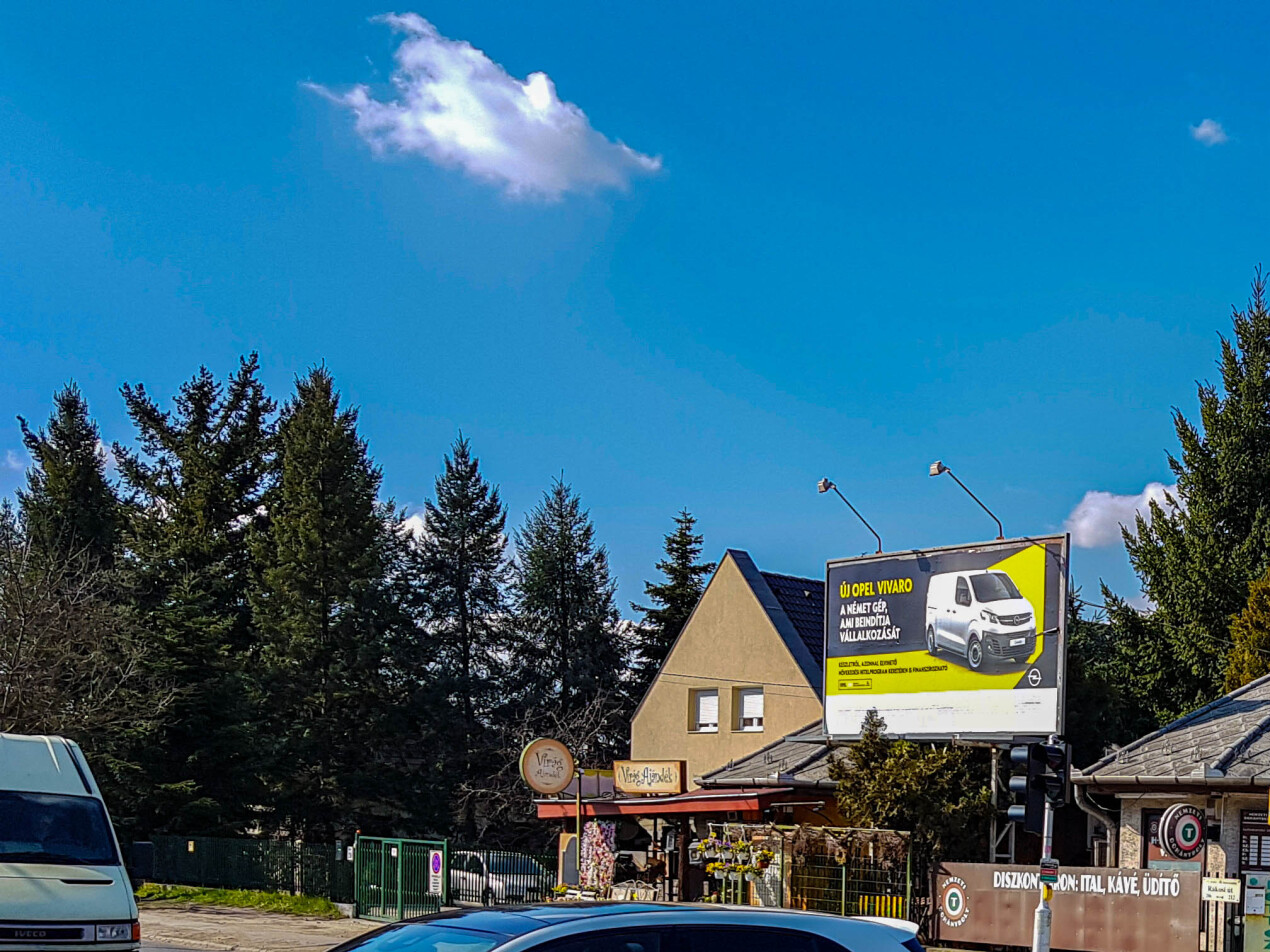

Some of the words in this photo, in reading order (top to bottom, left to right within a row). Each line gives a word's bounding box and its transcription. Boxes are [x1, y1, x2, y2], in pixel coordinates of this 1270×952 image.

[840, 580, 850, 598] ÚJ
[852, 582, 875, 597] OPEL
[877, 578, 913, 594] VIVARO
[840, 605, 846, 615] A
[847, 601, 871, 615] NÉMET
[872, 599, 888, 613] GÉP,
[840, 617, 854, 629] AMI
[855, 613, 891, 627] BEINDÍTJA
[840, 625, 901, 643] VÁLLALKOZÁSÁT
[535, 752, 564, 771] Virág
[621, 766, 642, 787] Virág
[642, 766, 673, 786] Ajándék
[1174, 807, 1203, 820] NEMZETI
[1185, 828, 1194, 838] T
[941, 876, 967, 890] NEMZETI
[1051, 874, 1079, 891] RON:
[1080, 874, 1106, 895] ITAL,
[1108, 871, 1140, 896] KÁVÉ,
[1143, 873, 1180, 897] ÜDÍTŐ
[951, 897, 958, 907] T
[15, 930, 47, 938] IVECO
